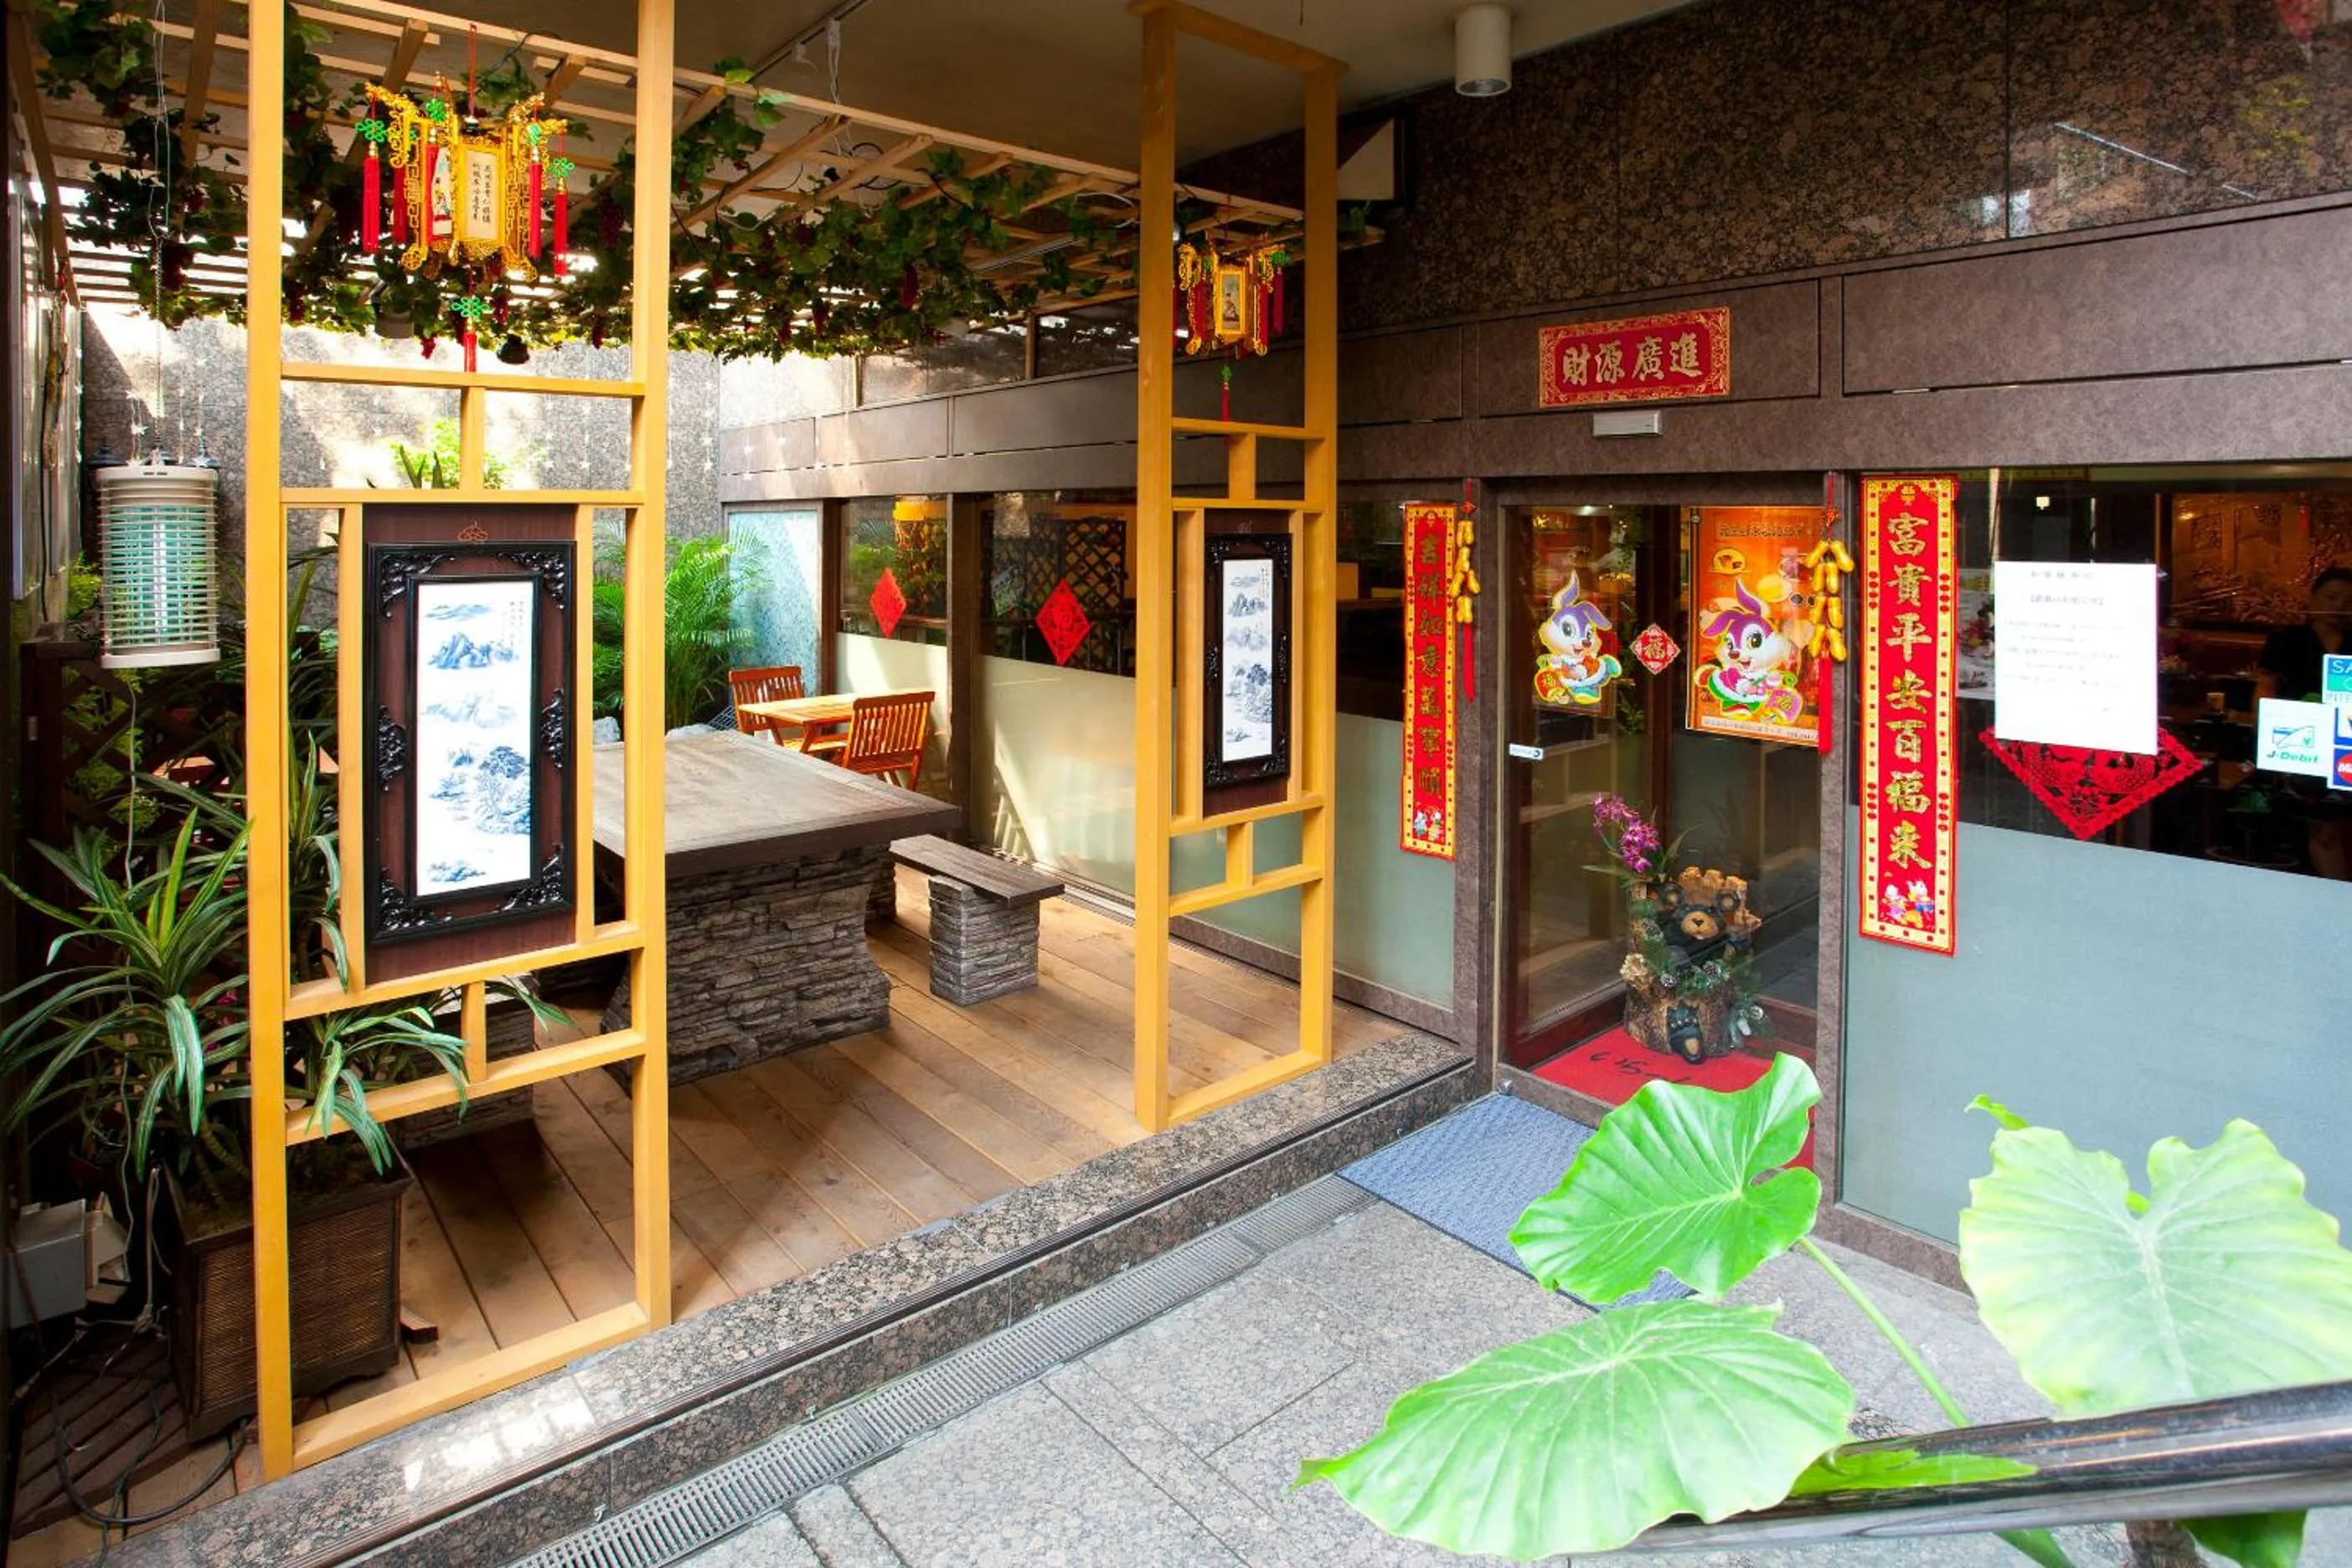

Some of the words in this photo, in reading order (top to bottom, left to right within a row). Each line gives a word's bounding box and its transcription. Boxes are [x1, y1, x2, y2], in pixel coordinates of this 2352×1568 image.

[1562, 332, 1703, 387] 財源廣進
[2267, 750, 2318, 764] J-Debit
